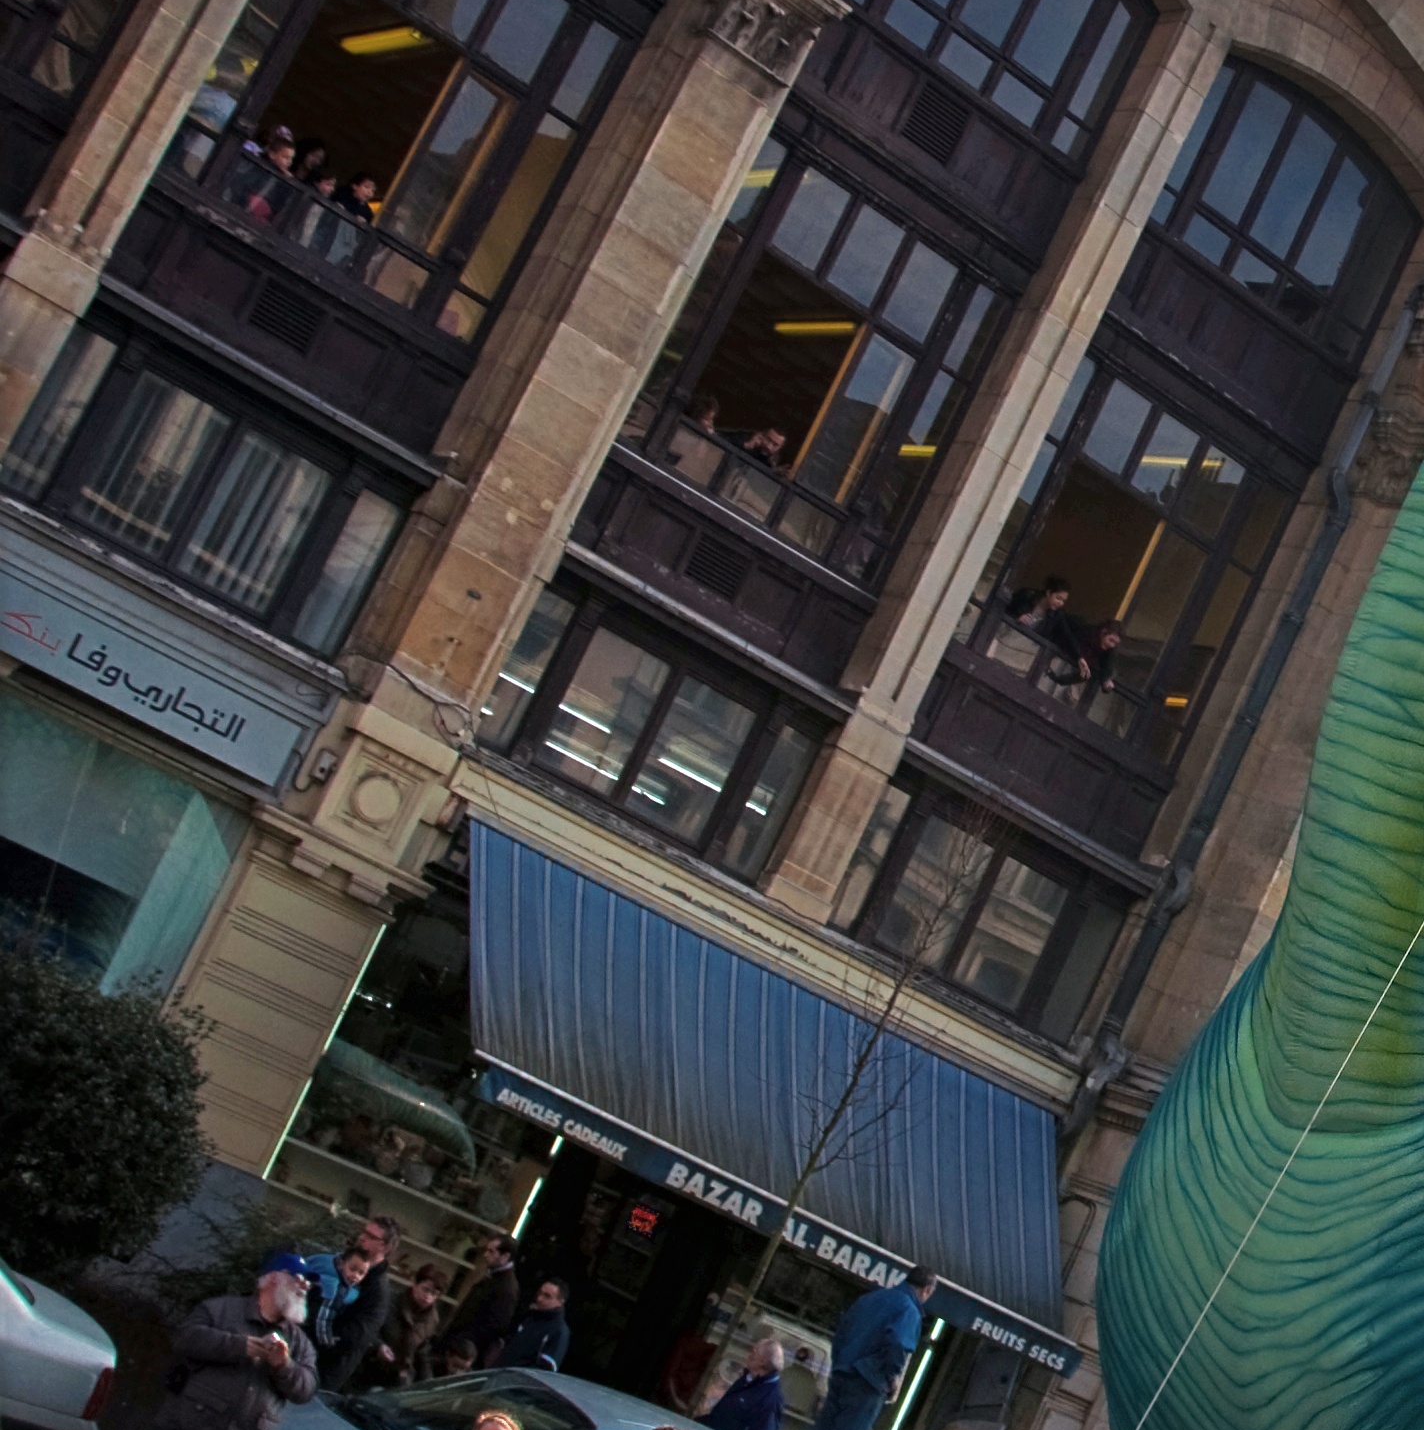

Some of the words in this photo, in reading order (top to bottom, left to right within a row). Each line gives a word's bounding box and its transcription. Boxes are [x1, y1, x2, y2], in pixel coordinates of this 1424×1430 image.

[496, 1087, 563, 1129] ARTICLES
[562, 1119, 629, 1162] CADEAUX
[665, 1162, 764, 1226] BAZAR
[781, 1215, 908, 1289] AL-BARAK
[971, 1316, 1027, 1352] FRUITS
[1028, 1344, 1067, 1372] SECS
